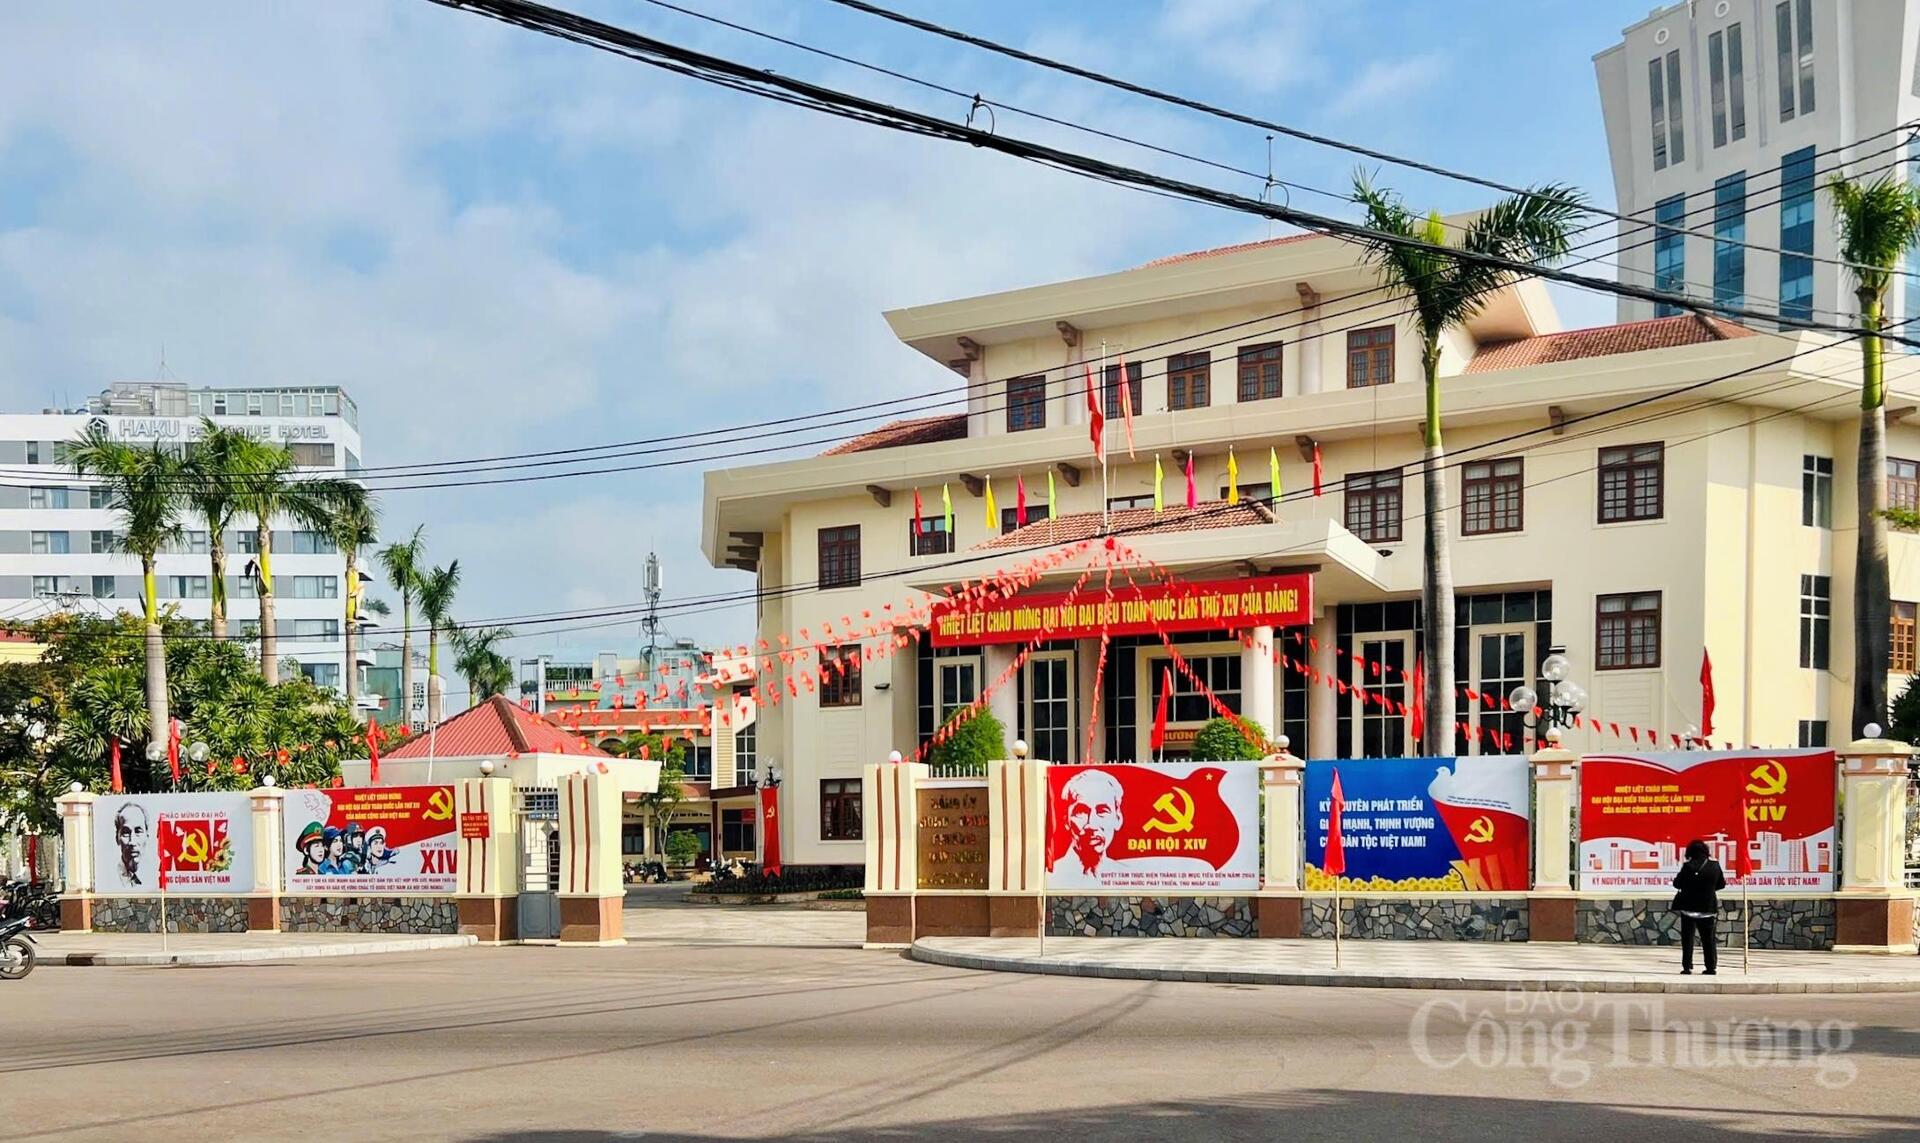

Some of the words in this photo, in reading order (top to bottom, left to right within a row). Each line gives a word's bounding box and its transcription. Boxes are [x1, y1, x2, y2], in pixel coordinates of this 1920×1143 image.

[119, 419, 180, 438] HAKU
[278, 424, 329, 439] HOTEL
[966, 608, 985, 638] LIỆT
[987, 605, 1012, 633] CHÀO
[1013, 604, 1042, 631] MỪNG
[1060, 602, 1077, 632] HỘI
[1078, 603, 1095, 631] ĐẠI
[1149, 591, 1176, 621] QUỐC
[1221, 593, 1239, 617] XIV
[1242, 585, 1263, 615] CỦA
[1264, 583, 1299, 614] ĐẢNG!
[1371, 797, 1397, 812] PHÁT
[1397, 795, 1424, 811] TRIỂN
[1342, 818, 1373, 831] MẠNH,
[1374, 818, 1401, 831] THỊNH
[1402, 816, 1435, 831] VƯỢNG
[1127, 838, 1152, 852] ĐẠI
[1155, 836, 1180, 852] HỘI
[1183, 838, 1208, 850] XIV
[1360, 834, 1378, 849] TỘC
[1379, 833, 1399, 849] VIỆT
[1400, 835, 1426, 847] NAM!
[420, 849, 457, 874] XIV
[1601, 876, 1625, 885] NGUYÊN
[1627, 876, 1642, 885] PHÁT
[1644, 875, 1661, 885] TRIỂN
[1758, 876, 1772, 885] DÂN
[1773, 876, 1786, 887] TỘC
[1787, 876, 1801, 886] VIỆT
[1802, 877, 1820, 885] NAM!
